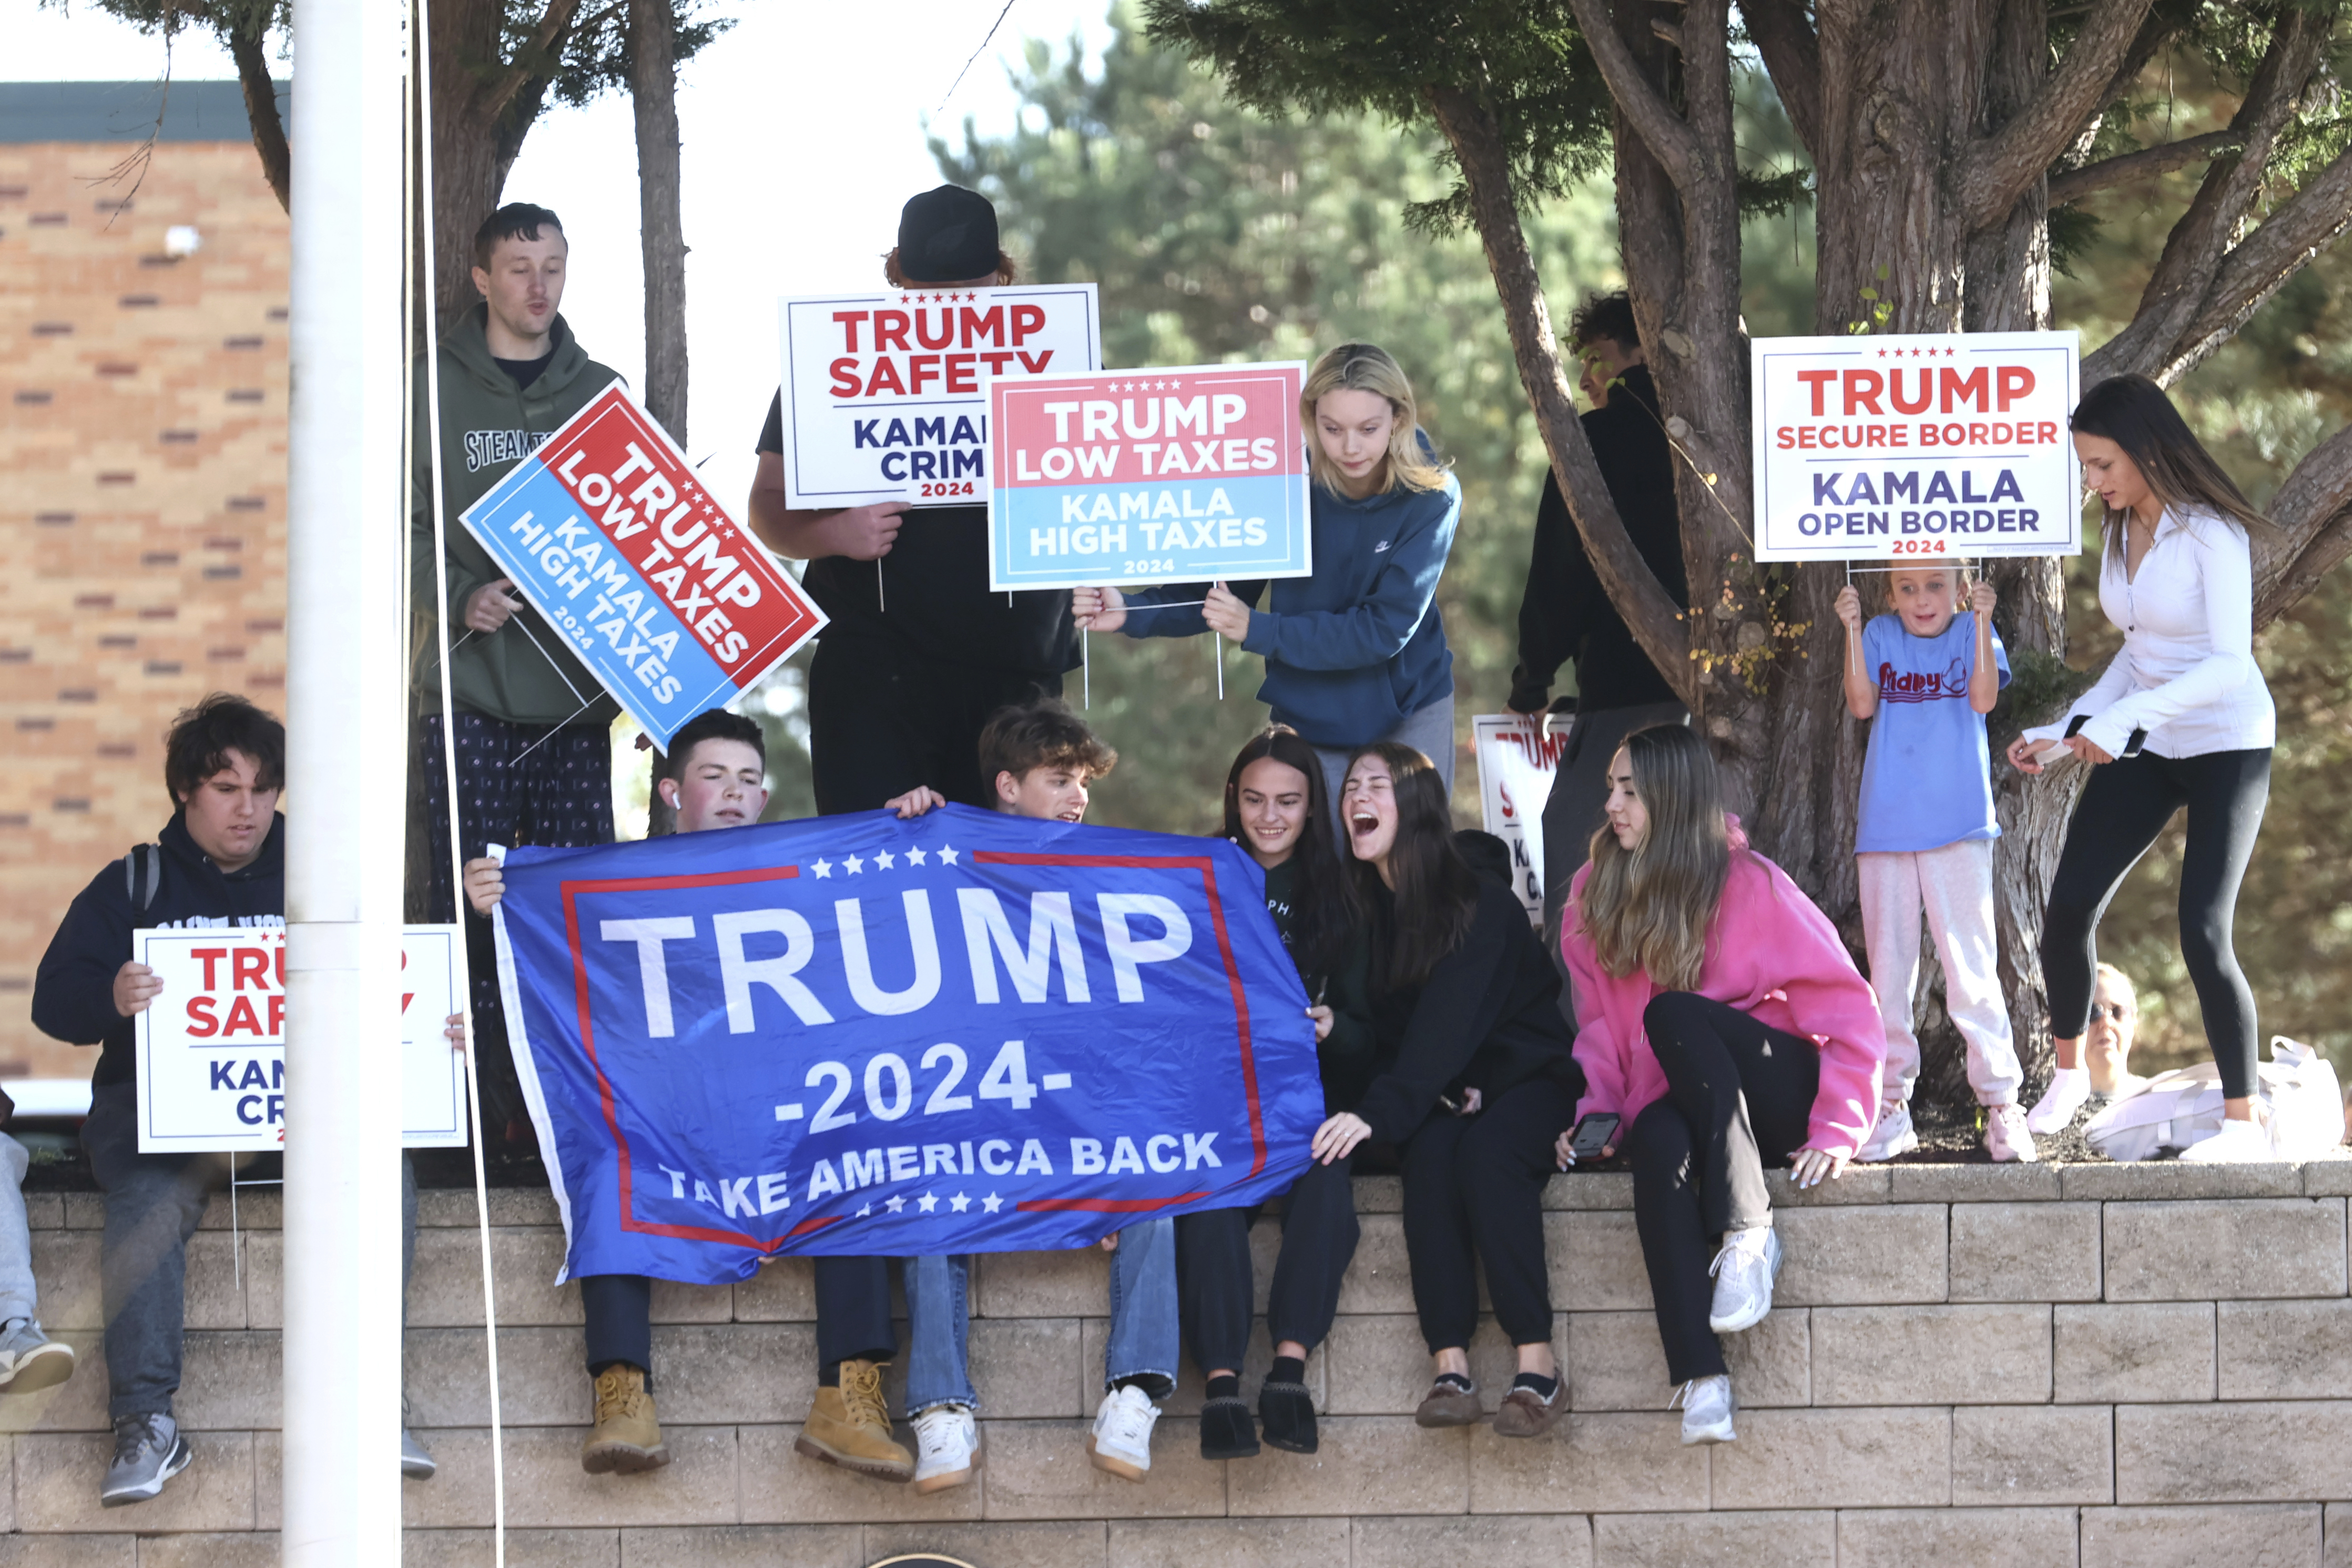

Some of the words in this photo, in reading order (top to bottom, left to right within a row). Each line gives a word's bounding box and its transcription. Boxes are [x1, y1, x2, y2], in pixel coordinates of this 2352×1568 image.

[832, 304, 1045, 353] TRUMP
[829, 350, 1053, 398] SAFETY
[1798, 365, 2035, 416] TRUMP
[854, 415, 986, 448] KAMA
[1043, 394, 1247, 443] TRUMP
[1777, 424, 1908, 449] SECURE
[1920, 421, 2057, 446] BORDER
[464, 430, 554, 473] STEAMT
[881, 449, 984, 481] CRIM
[1015, 445, 1119, 481] LOW
[1139, 437, 1278, 475] TAXES
[921, 482, 974, 497] 2024
[1062, 487, 1235, 523] KAMALA
[1813, 469, 2024, 506] KAMALA
[611, 441, 761, 608] TRUMP
[1030, 524, 1127, 557] HIGH
[1139, 517, 1267, 551] TAXES
[1798, 512, 1889, 535] OPEN
[1901, 508, 2039, 534] BORDER
[557, 450, 647, 542] LOW
[640, 538, 749, 664] TAXES
[1124, 558, 1175, 575] 2024
[1892, 540, 1946, 554] 2024
[510, 511, 592, 600] HIGH
[586, 594, 682, 705] TAXES
[555, 515, 681, 661] KAMALA
[554, 606, 594, 649] 2024
[600, 888, 1193, 1039] TRUMP
[657, 1163, 791, 1219] TAKE
[807, 1136, 1053, 1203] AMERICA
[1070, 1131, 1223, 1177] BACK
